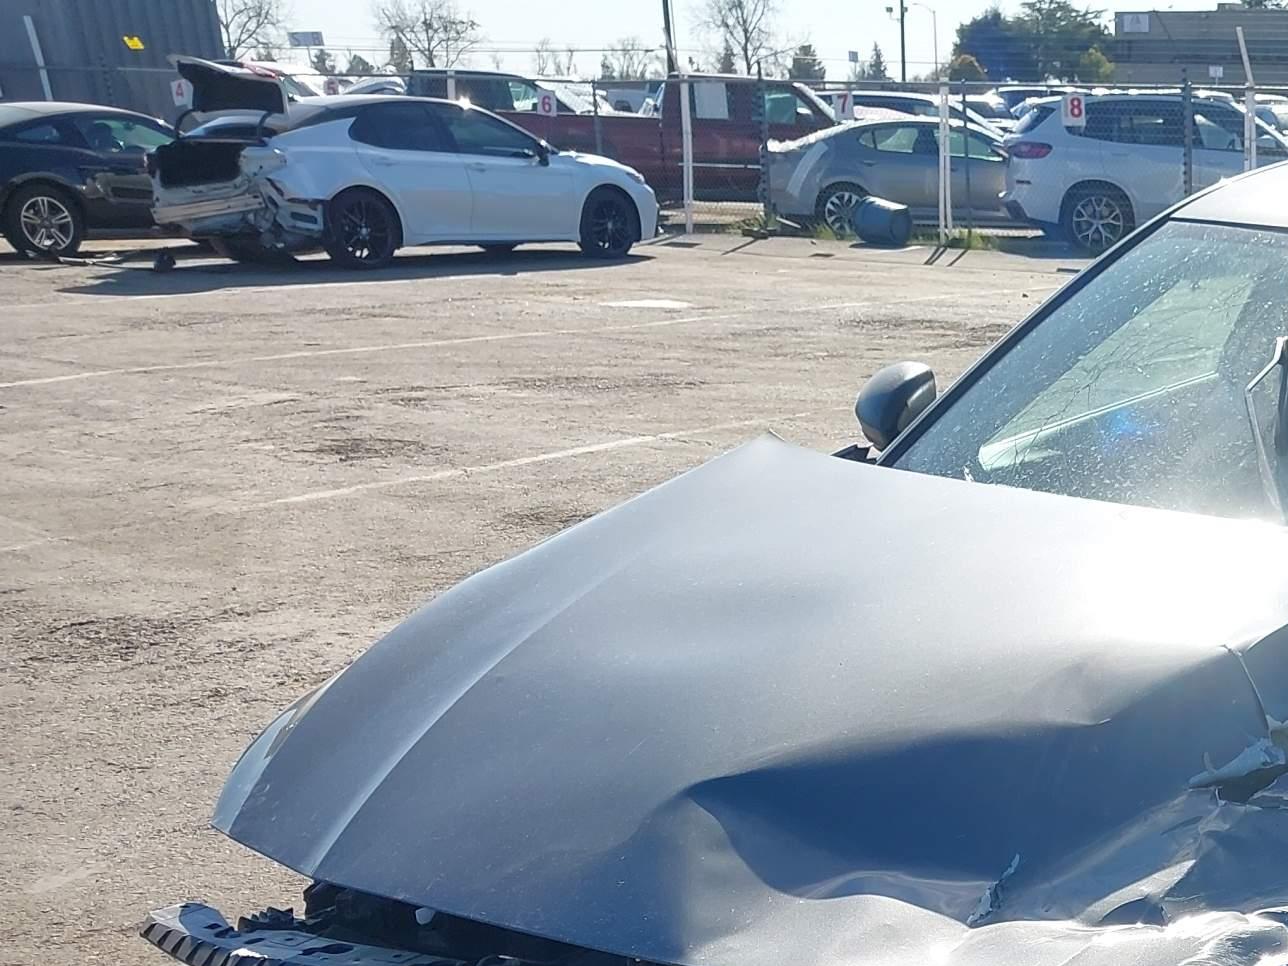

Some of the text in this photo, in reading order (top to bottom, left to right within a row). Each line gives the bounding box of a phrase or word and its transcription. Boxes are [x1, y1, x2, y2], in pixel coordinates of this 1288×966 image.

[541, 95, 552, 113] 6
[837, 93, 848, 114] 7
[1070, 97, 1082, 118] 8
